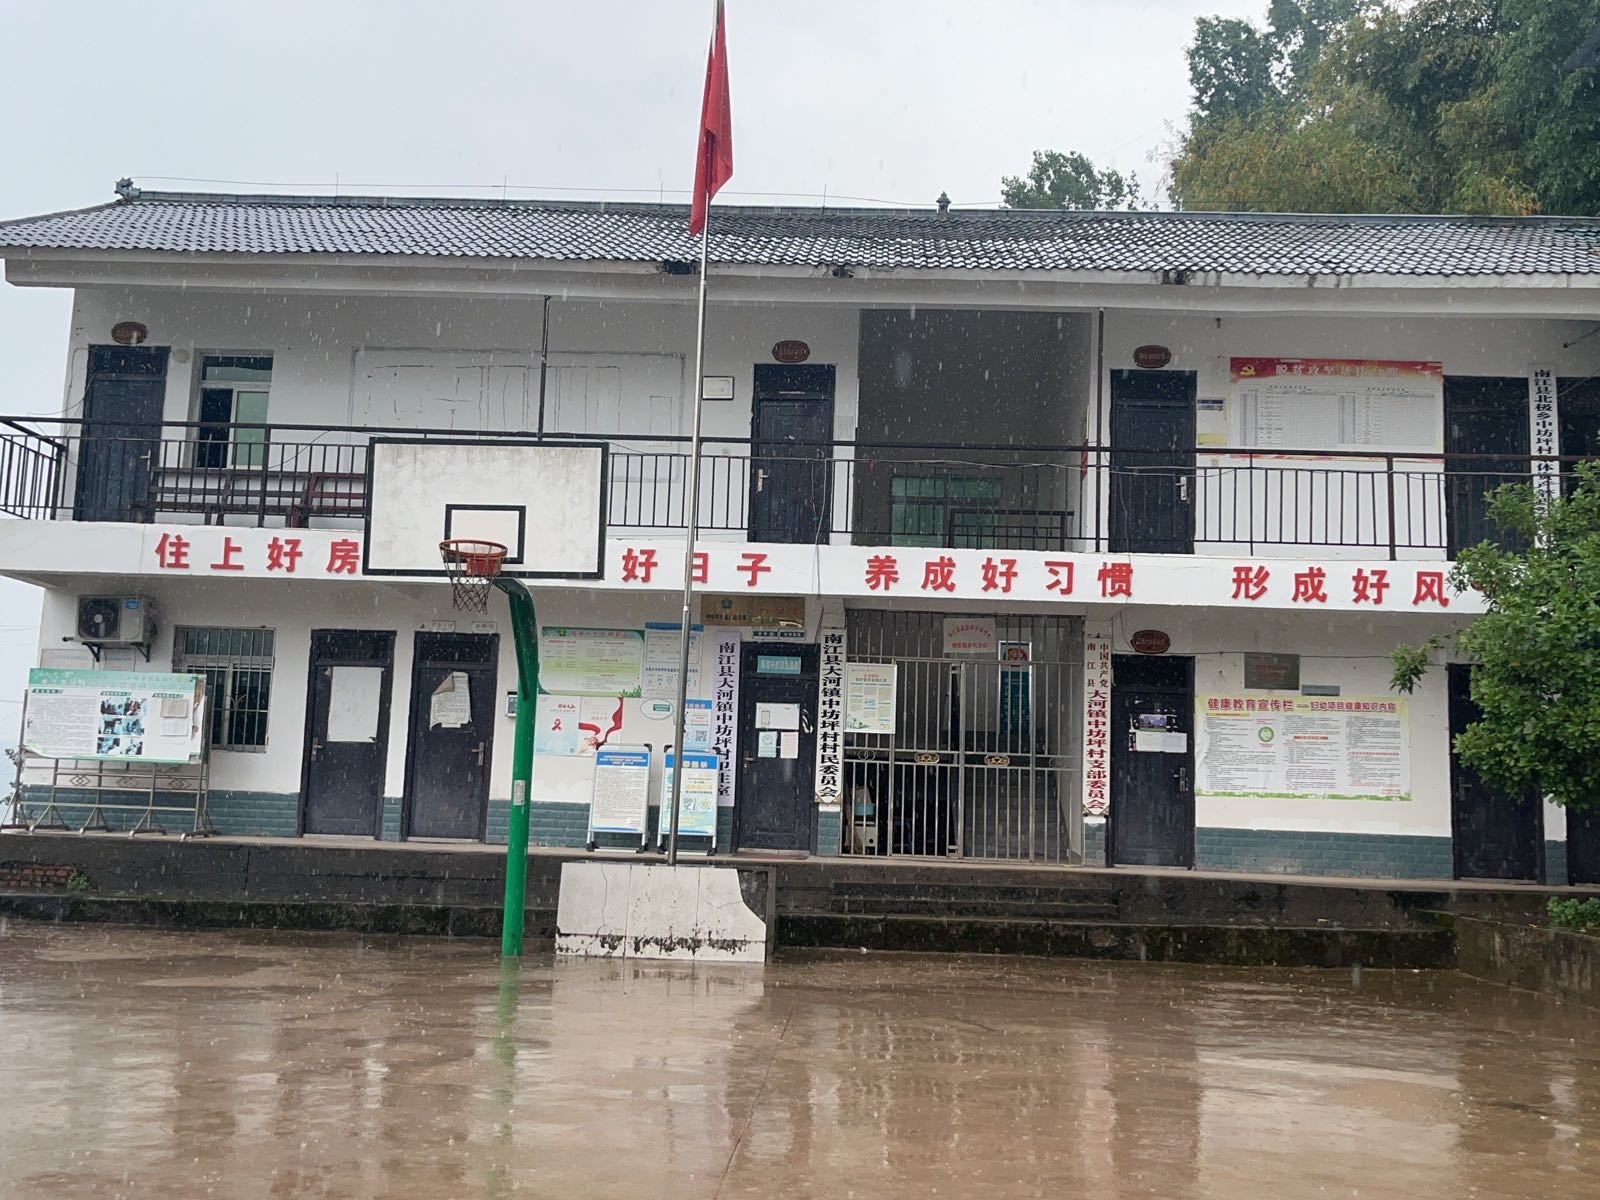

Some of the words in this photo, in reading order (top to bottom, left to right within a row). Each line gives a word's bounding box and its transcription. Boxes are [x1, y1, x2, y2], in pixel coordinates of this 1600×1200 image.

[155, 533, 360, 574] 住上好房
[622, 547, 772, 587] 好日子
[865, 554, 1133, 598] 养成好习惯
[1231, 565, 1450, 607] 形成好风
[818, 633, 843, 798] 南江县大河镇中坊坪村村民委员会
